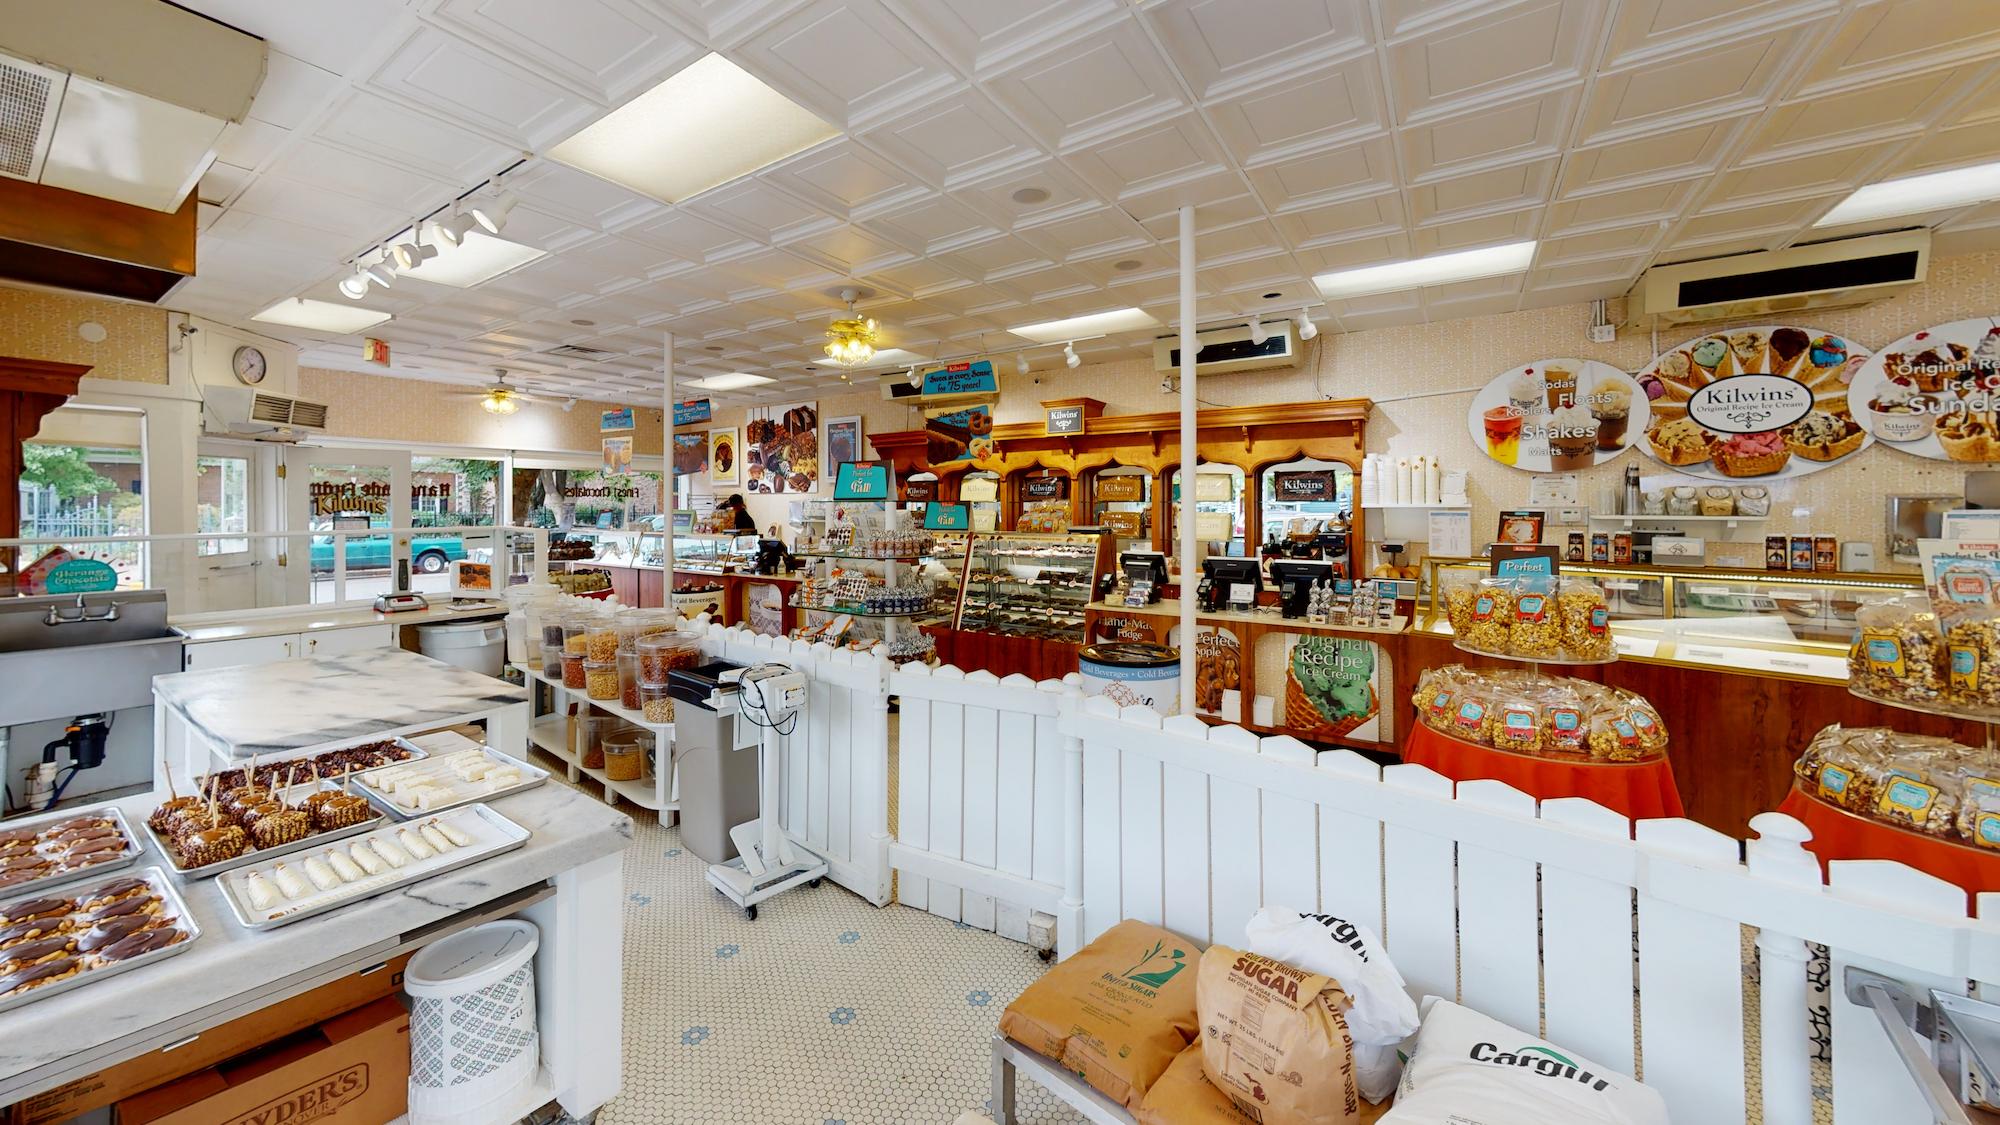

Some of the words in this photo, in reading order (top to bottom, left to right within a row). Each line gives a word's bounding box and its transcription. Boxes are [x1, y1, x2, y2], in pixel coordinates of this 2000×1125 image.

[1897, 361, 1972, 377] Original
[1537, 379, 1575, 389] Sodas
[1943, 378, 1976, 391] Ice
[1558, 392, 1613, 406] Floats
[1706, 387, 1795, 404] Kilwins
[1050, 410, 1078, 420] Kilwins
[1506, 407, 1551, 416] Koolers
[1696, 405, 1730, 413] Original
[1522, 423, 1596, 440] Shakes
[1528, 446, 1562, 456] Malts
[1029, 484, 1056, 492] Kilwins
[1104, 483, 1134, 492] Kilwins
[1284, 479, 1324, 490] Kilwins
[1104, 519, 1134, 529] Kilwins
[1504, 560, 1545, 573] Perfect
[1117, 628, 1144, 641] Fudge
[1300, 648, 1364, 672] Recipe
[1095, 667, 1129, 679] Beverages
[1137, 669, 1157, 679] Cold
[1302, 665, 1320, 676] Ice
[1322, 667, 1361, 681] Cream
[1232, 957, 1299, 1003] SUGAR
[1271, 994, 1298, 1012] COMPANY
[1469, 1041, 1611, 1092] Cargill
